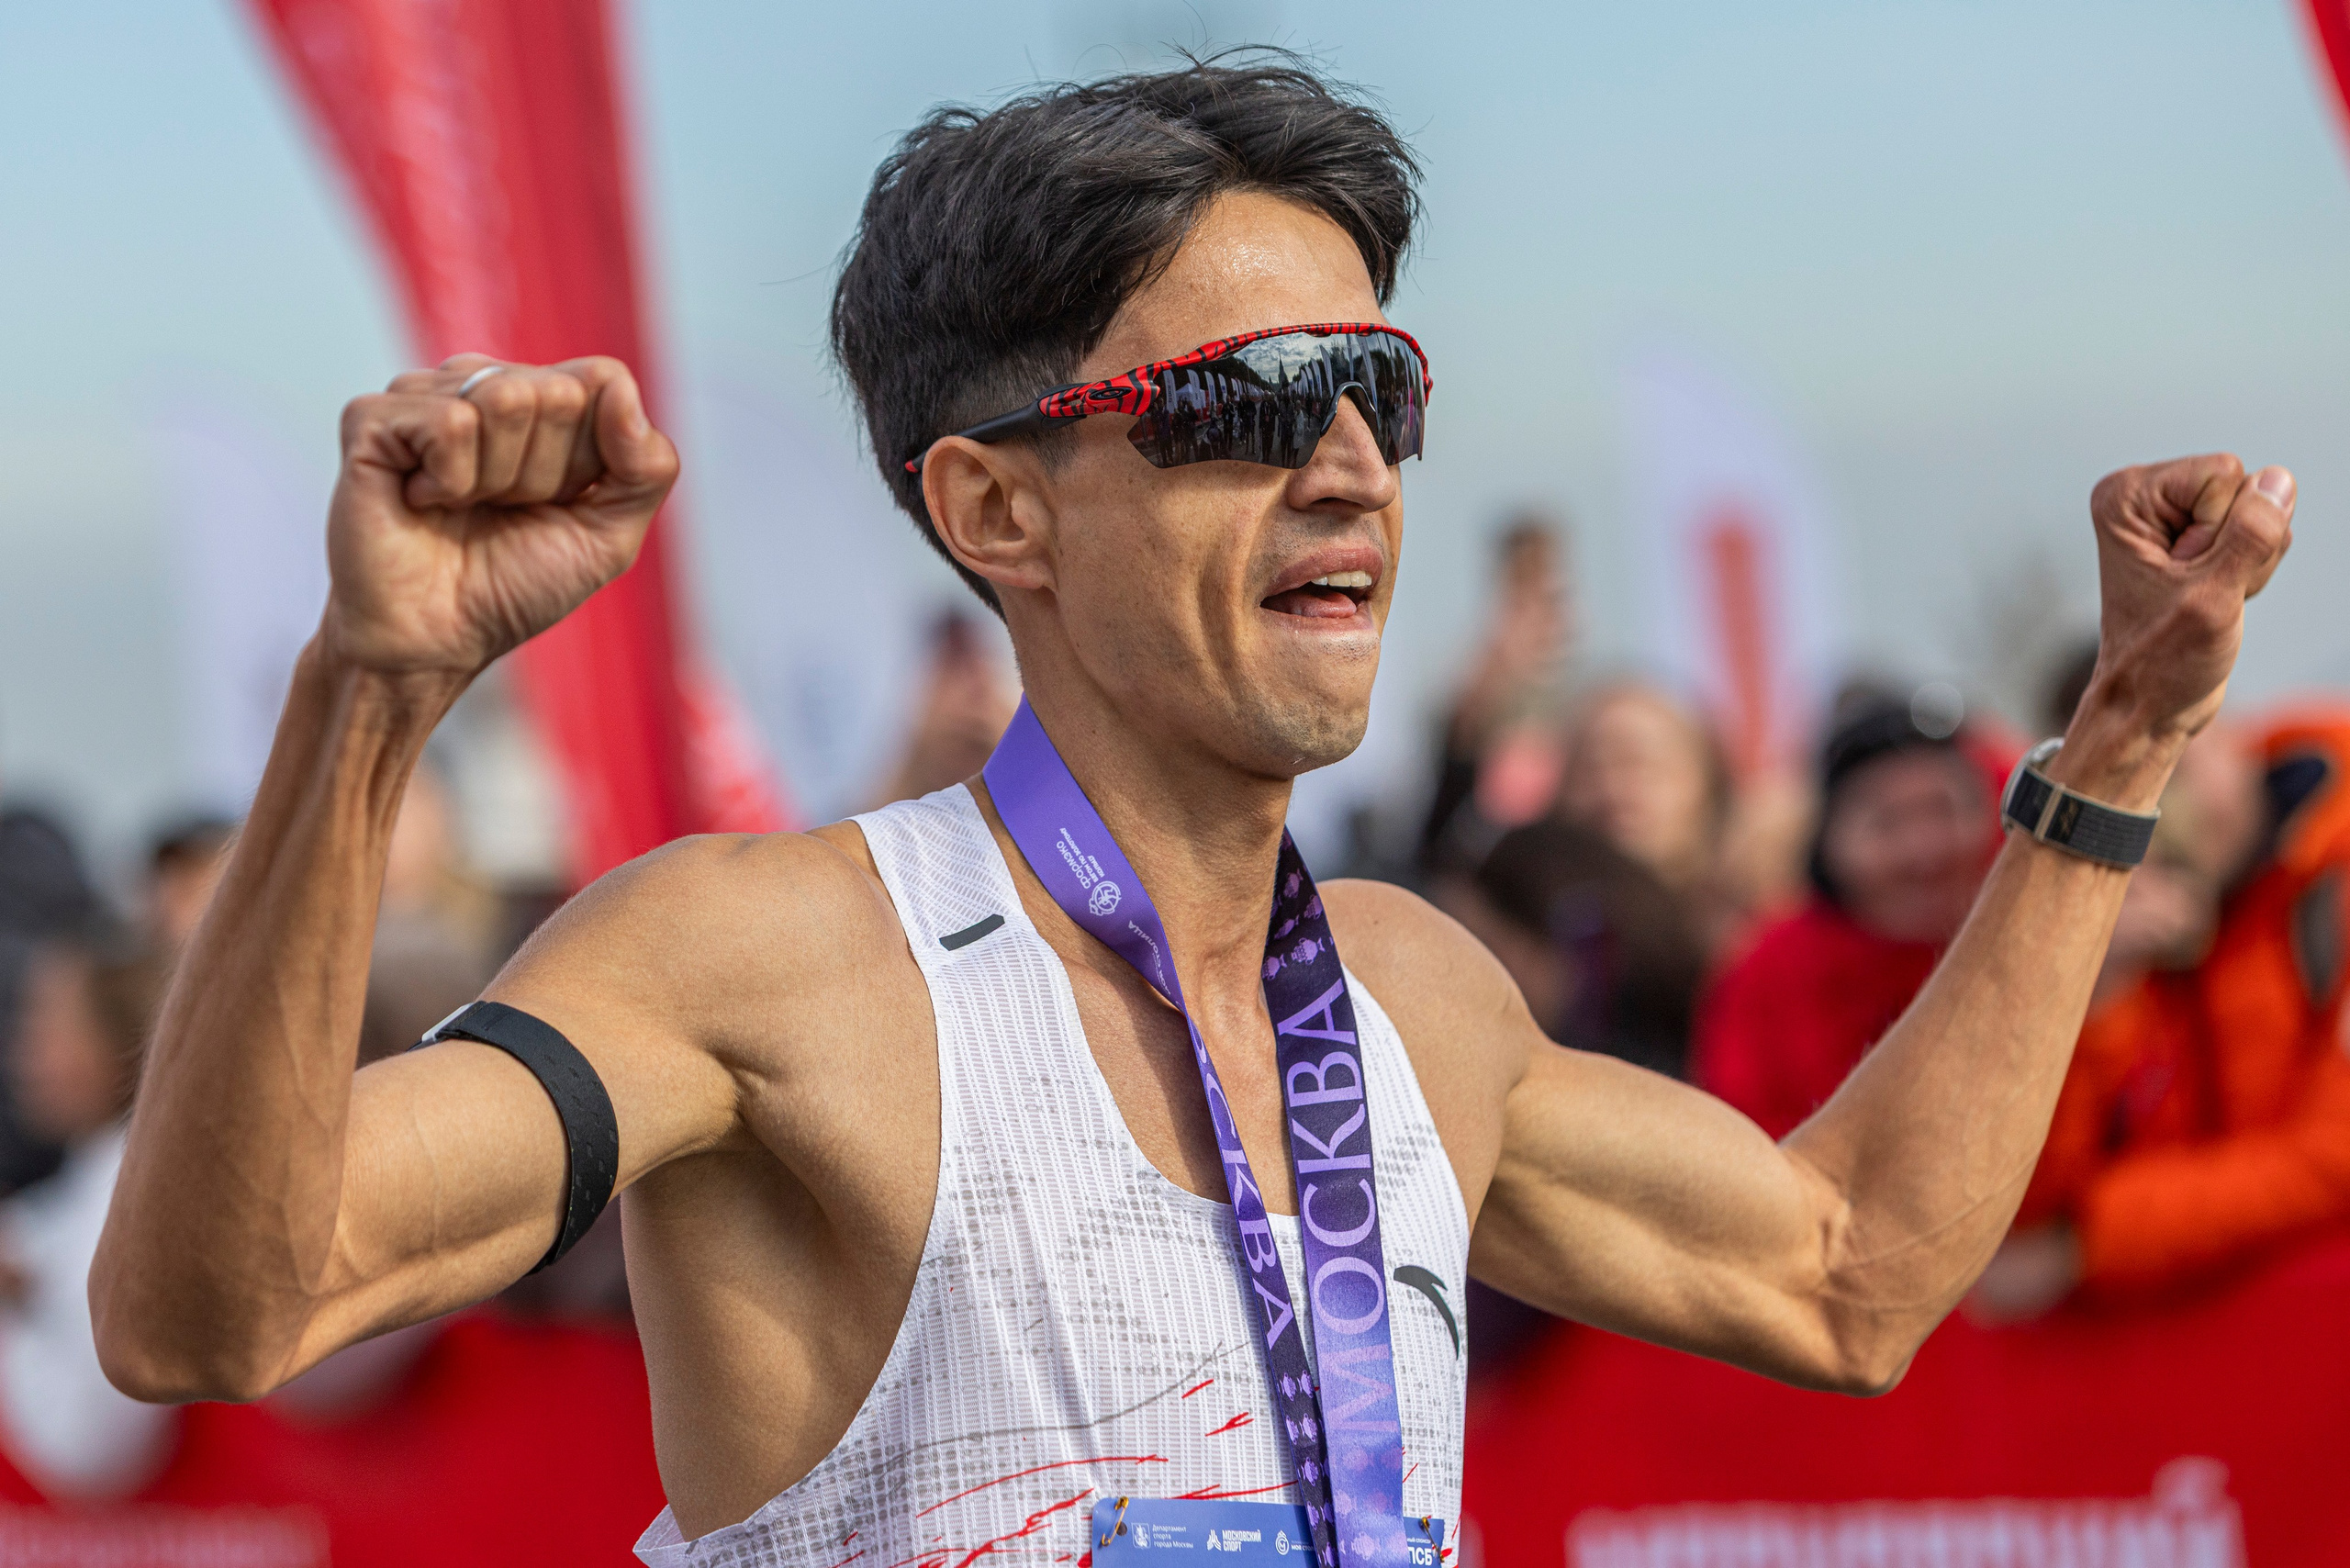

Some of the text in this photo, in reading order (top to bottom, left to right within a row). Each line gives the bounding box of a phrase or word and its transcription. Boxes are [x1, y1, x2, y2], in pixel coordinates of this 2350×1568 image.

[1057, 841, 1091, 889] фармэко
[1128, 920, 1161, 968] СТОЛИЦА
[1277, 978, 1399, 1432] МОСКВА
[1222, 1529, 1262, 1543] МОСКОВСКИЙ
[1223, 1540, 1242, 1552] СПОРТ
[1407, 1546, 1433, 1566] ПСБ
